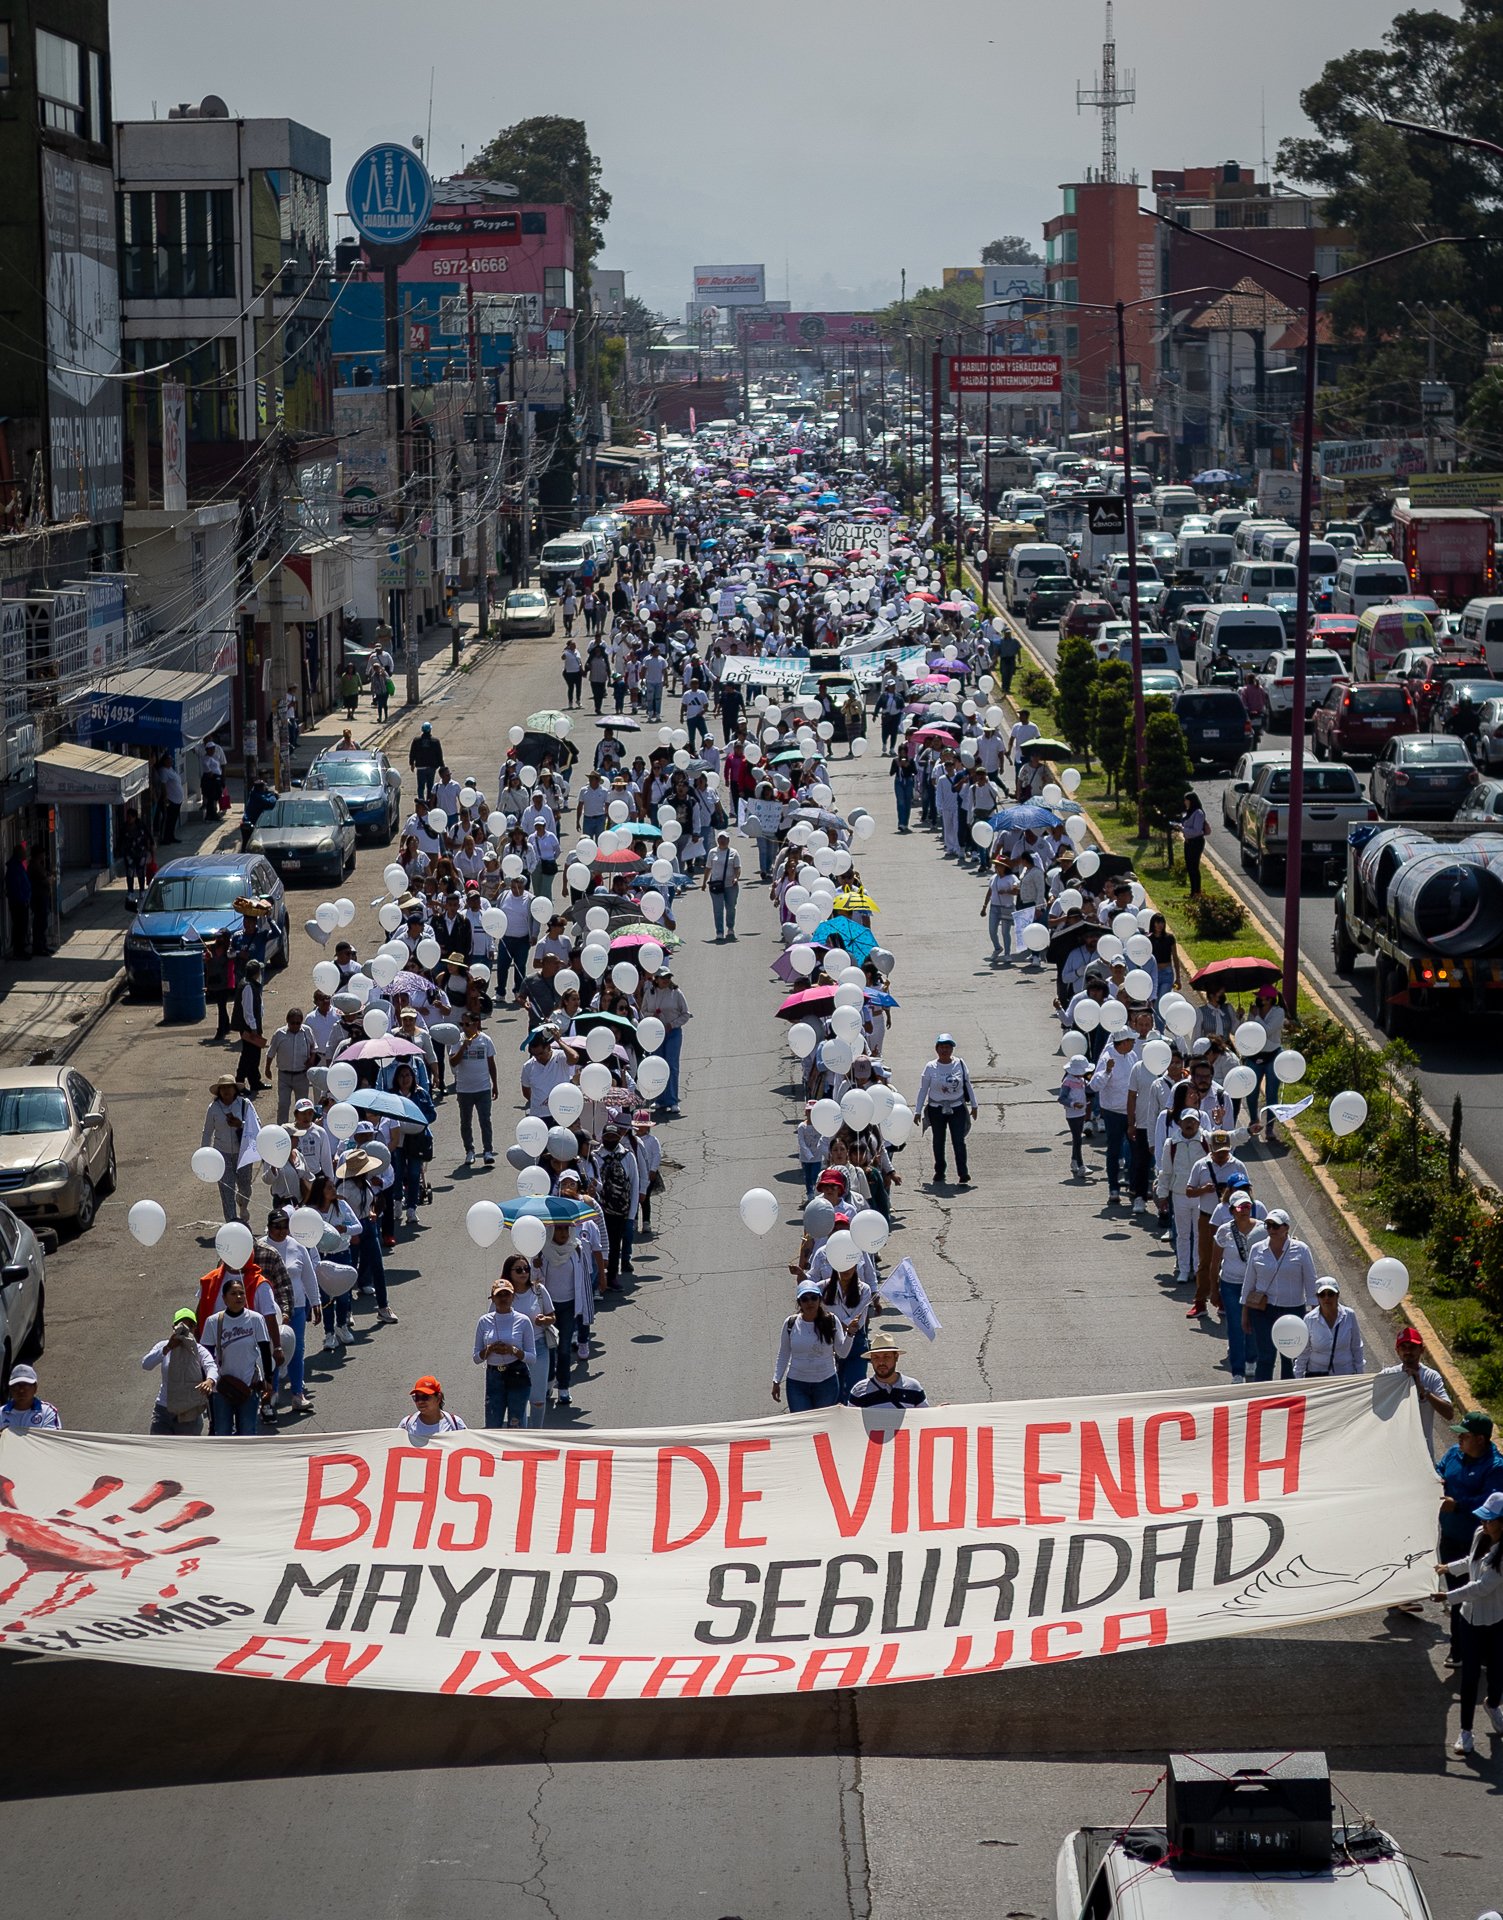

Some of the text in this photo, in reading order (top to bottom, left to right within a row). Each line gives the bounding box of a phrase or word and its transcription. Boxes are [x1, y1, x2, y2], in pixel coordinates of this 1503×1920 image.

[384, 151, 394, 206] FARMACIAS
[362, 214, 415, 228] GUADALAJARA
[473, 217, 510, 229] Pizza
[433, 257, 508, 276] 5972-0668
[954, 359, 1005, 372] RHABILITCIÓN
[1012, 359, 1057, 372] SEÑALIZACIÓN
[959, 375, 1054, 386] IALIDADS INTERMUNICIPALES
[50, 416, 75, 469] PREPA
[97, 415, 122, 466] EXAMEN
[1324, 443, 1373, 460] GRAN VENTA
[1324, 454, 1383, 474] DE ZAPATOS
[342, 502, 379, 514] TOLTECA
[828, 537, 879, 552] VILLAS
[380, 567, 425, 577] San Plo
[110, 705, 135, 723] 4932
[294, 1395, 1307, 1554] BASTA DE VIOLENCIA
[263, 1511, 1286, 1646] MAYOR SEGURIDAD
[17, 1594, 256, 1653] EXIGIMOS
[214, 1607, 1169, 1700] EN IXTAPALUCA
